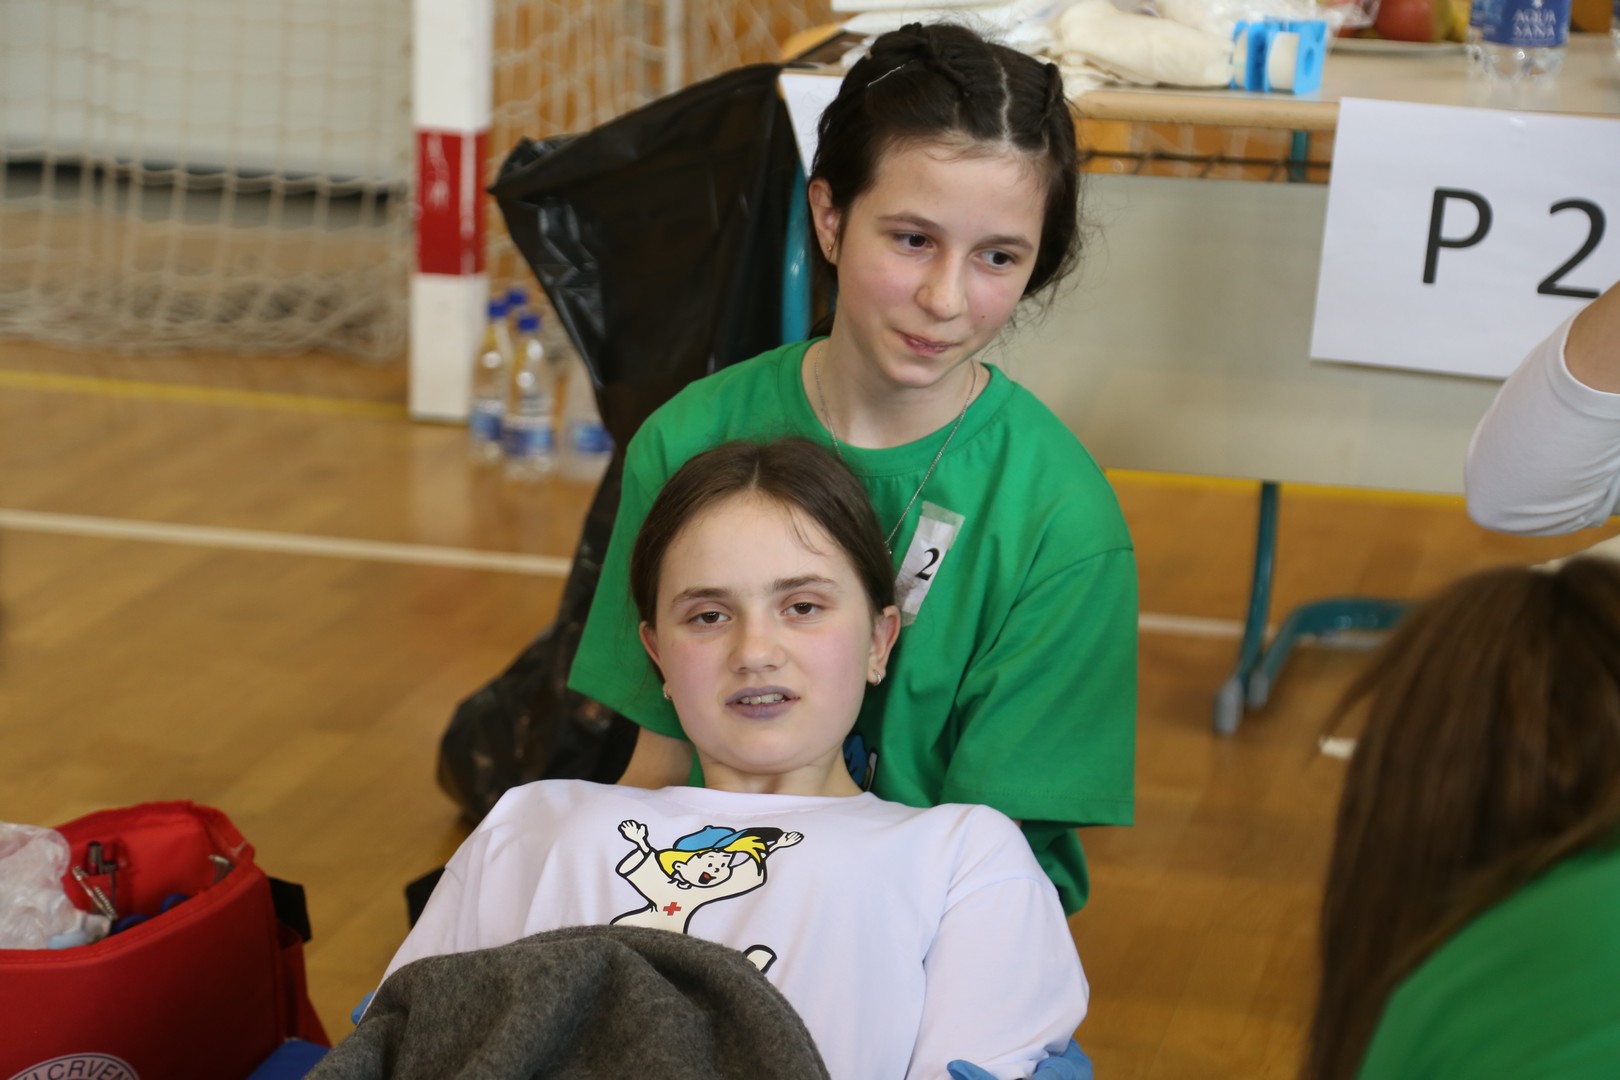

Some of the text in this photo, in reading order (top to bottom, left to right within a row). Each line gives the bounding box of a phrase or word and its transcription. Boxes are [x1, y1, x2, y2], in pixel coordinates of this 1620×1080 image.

[1512, 8, 1557, 24] AQUA
[1512, 23, 1556, 38] SANA
[1422, 186, 1607, 299] P 2
[914, 547, 941, 581] 2
